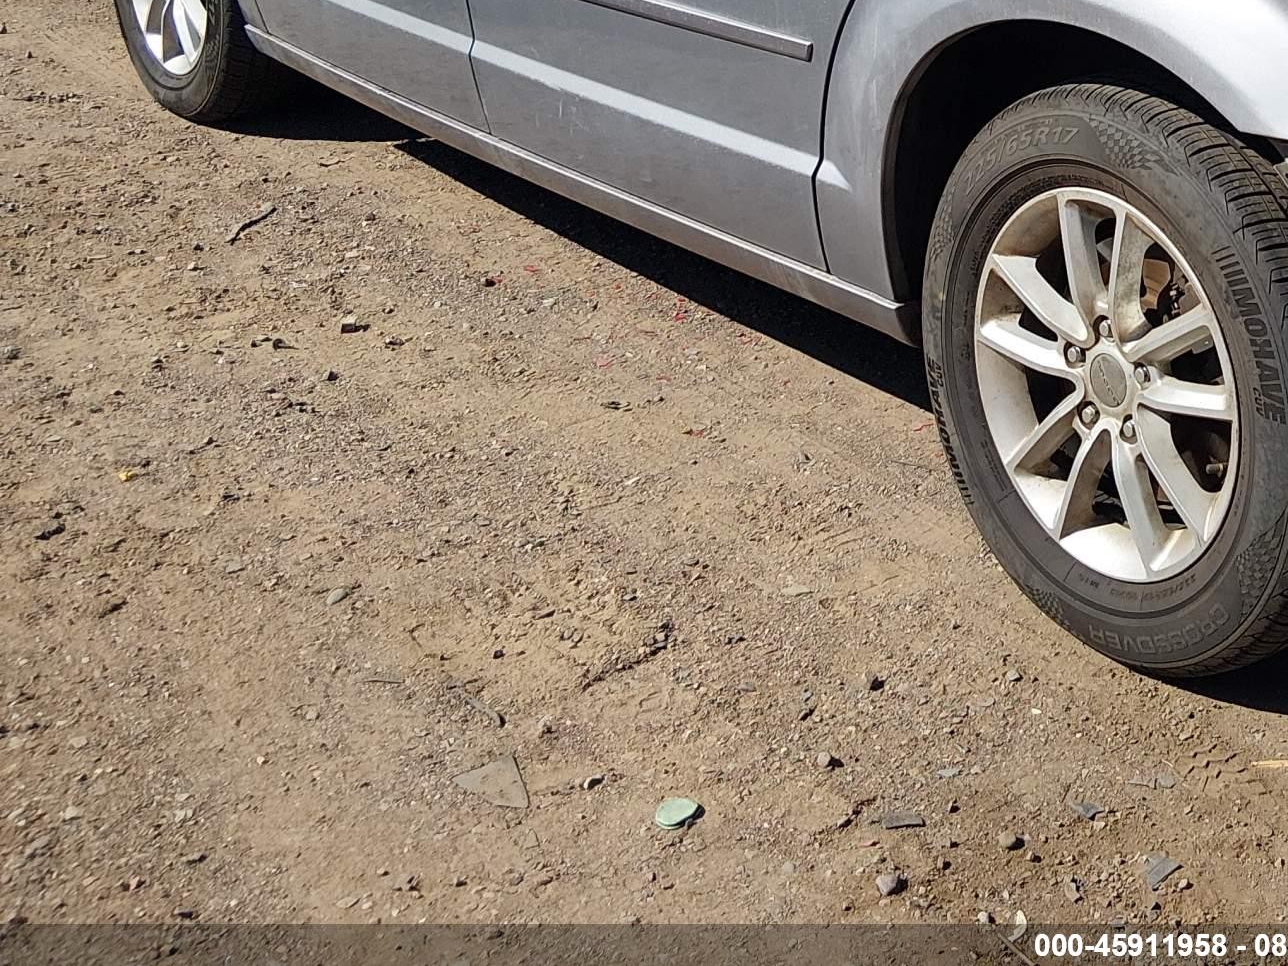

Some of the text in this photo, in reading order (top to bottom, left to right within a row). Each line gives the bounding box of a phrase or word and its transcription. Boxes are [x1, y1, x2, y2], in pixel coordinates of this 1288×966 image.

[963, 126, 1080, 194] 225/65R17
[1230, 286, 1287, 425] MOHAVE
[1252, 386, 1264, 417] CUV
[1088, 603, 1230, 655] CROSSOVER
